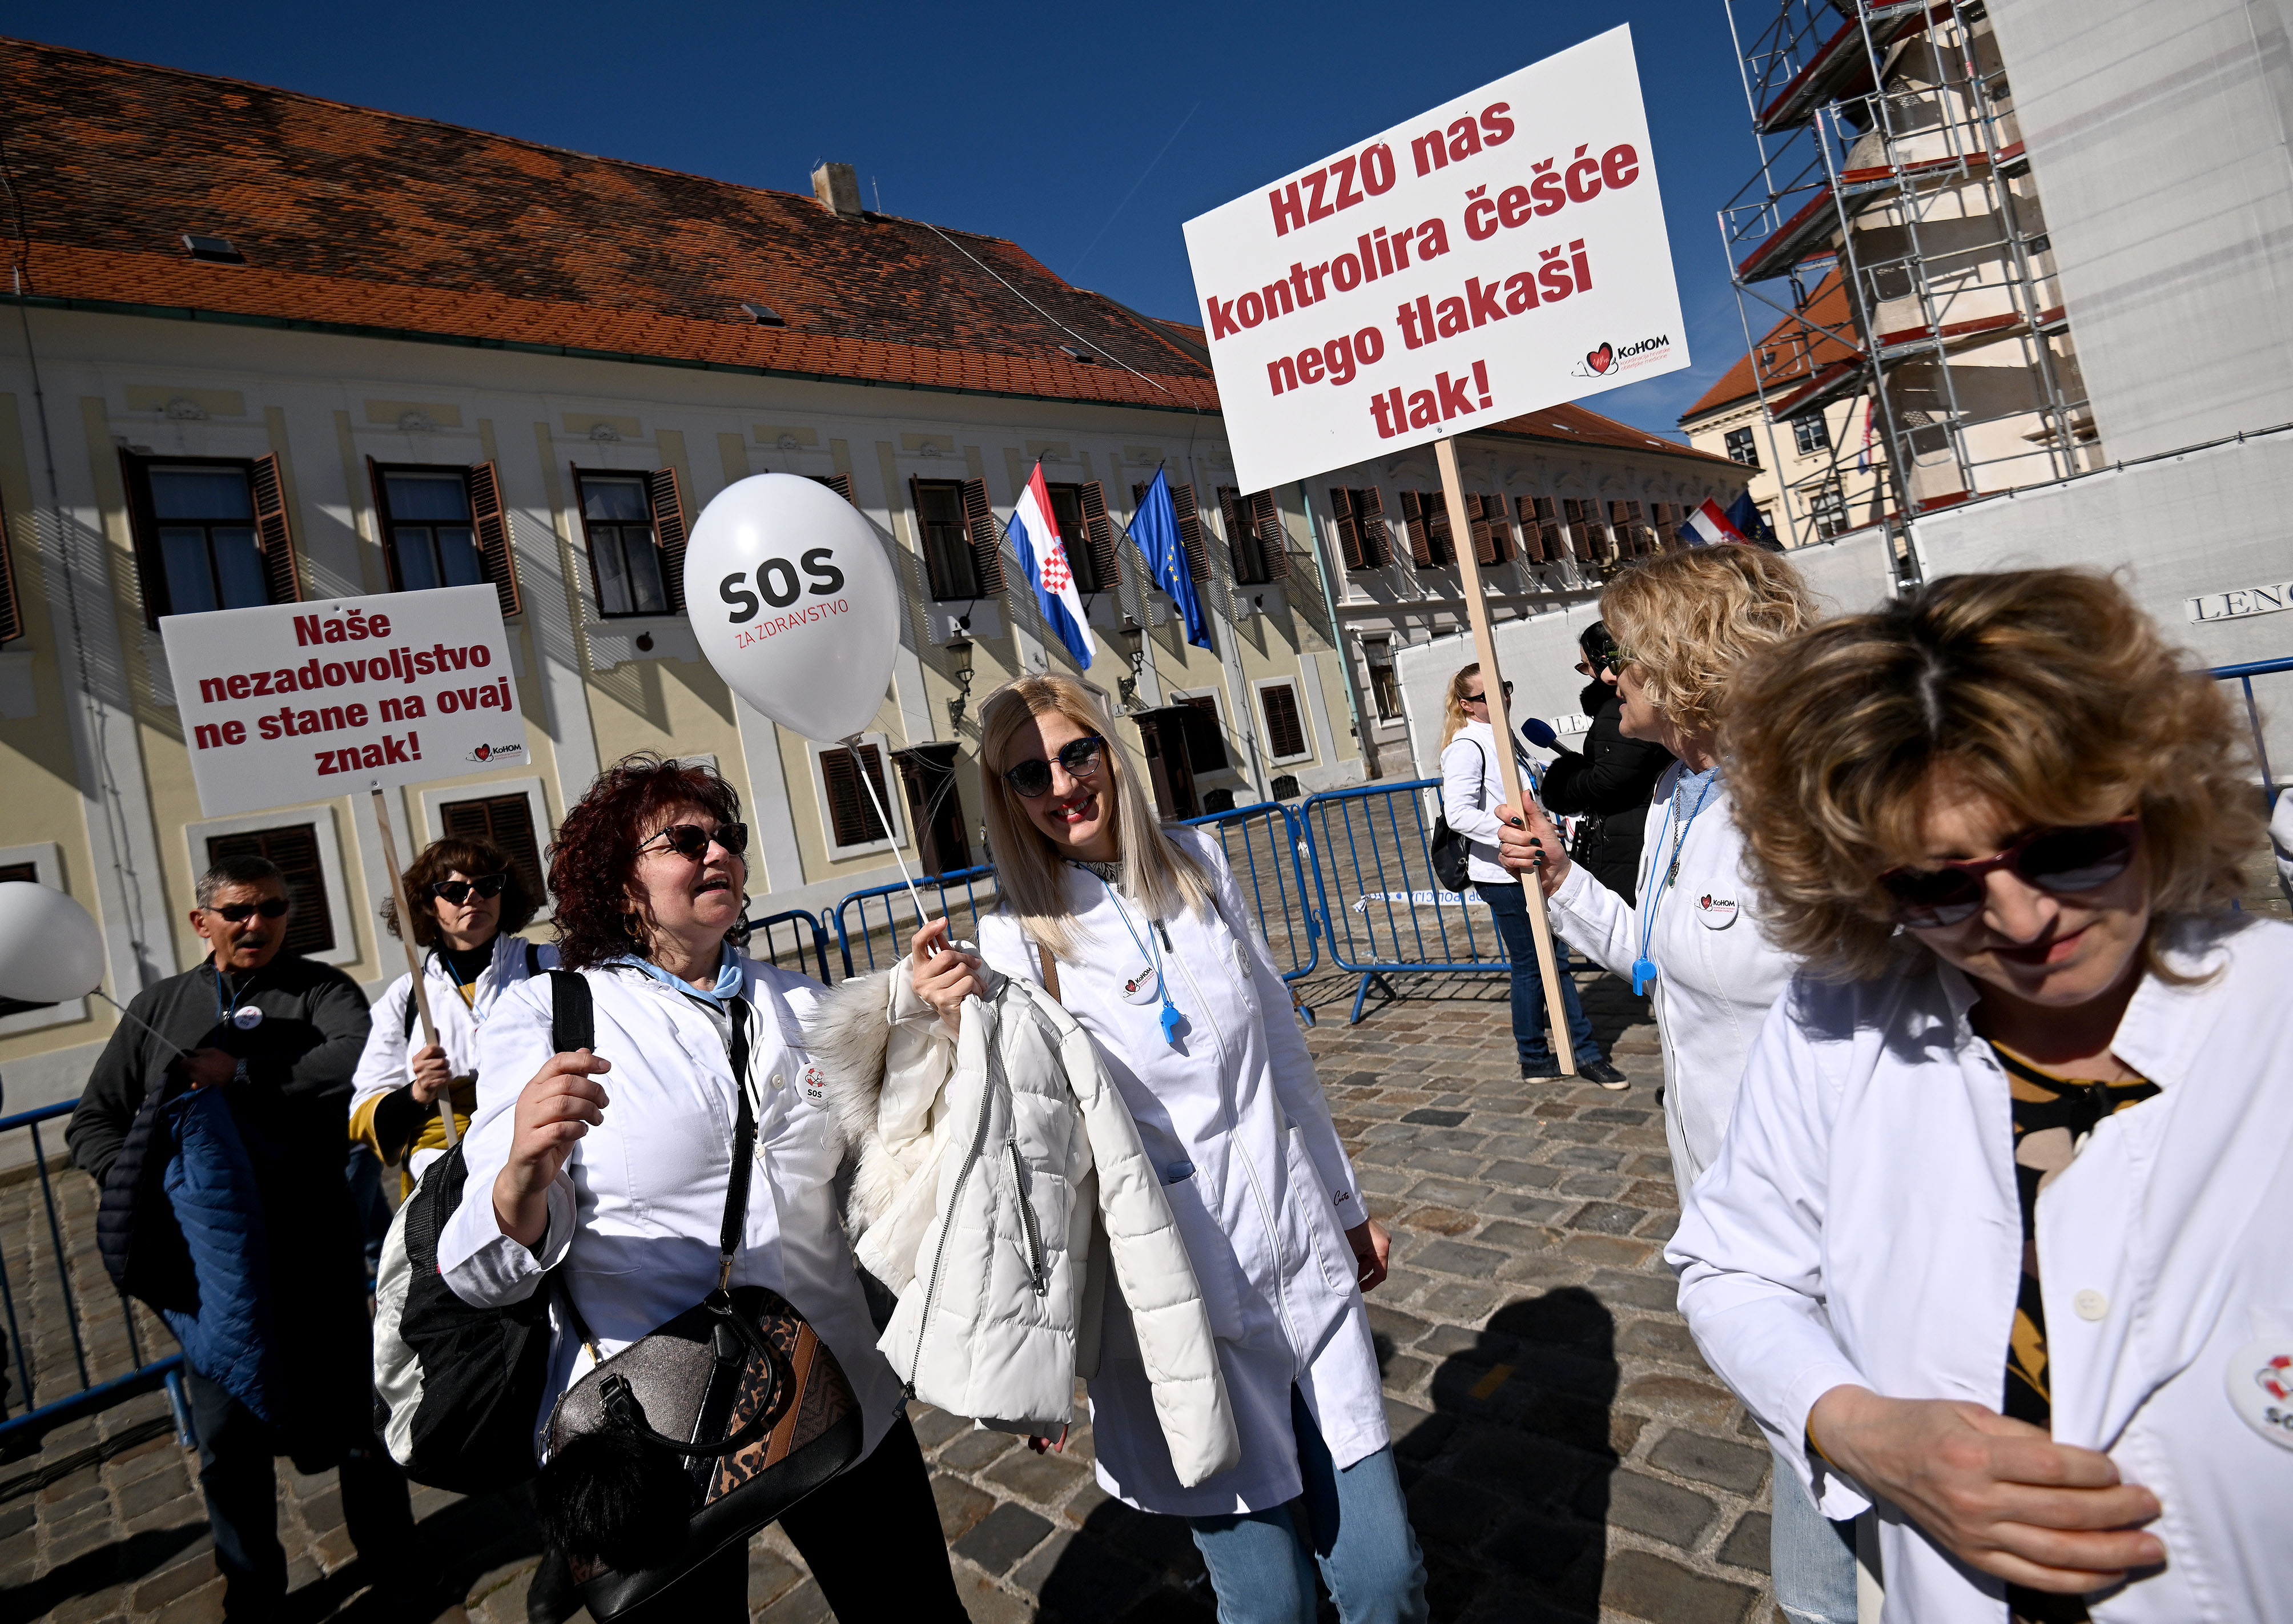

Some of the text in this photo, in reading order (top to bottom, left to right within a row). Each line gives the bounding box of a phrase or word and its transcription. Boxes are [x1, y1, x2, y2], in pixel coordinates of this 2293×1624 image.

[1269, 102, 1515, 238] HZZO nas
[1206, 143, 1639, 341] kontrolira češće
[1267, 238, 1593, 397] nego tlakaši
[1618, 334, 1670, 359] KoHOM
[1370, 359, 1493, 439] tlak!
[719, 548, 844, 624] SOS
[2190, 584, 2293, 621] LEN
[293, 609, 391, 646] Naše
[735, 599, 849, 649] ZA ZDRAVSTVO
[200, 644, 490, 703] nezadovoljstvo
[195, 676, 513, 750] ne stane na ovaj
[315, 731, 421, 775] znak!
[492, 743, 522, 754] KoHOM
[1135, 967, 1153, 984] KoHOM
[807, 1088, 822, 1098] SOS
